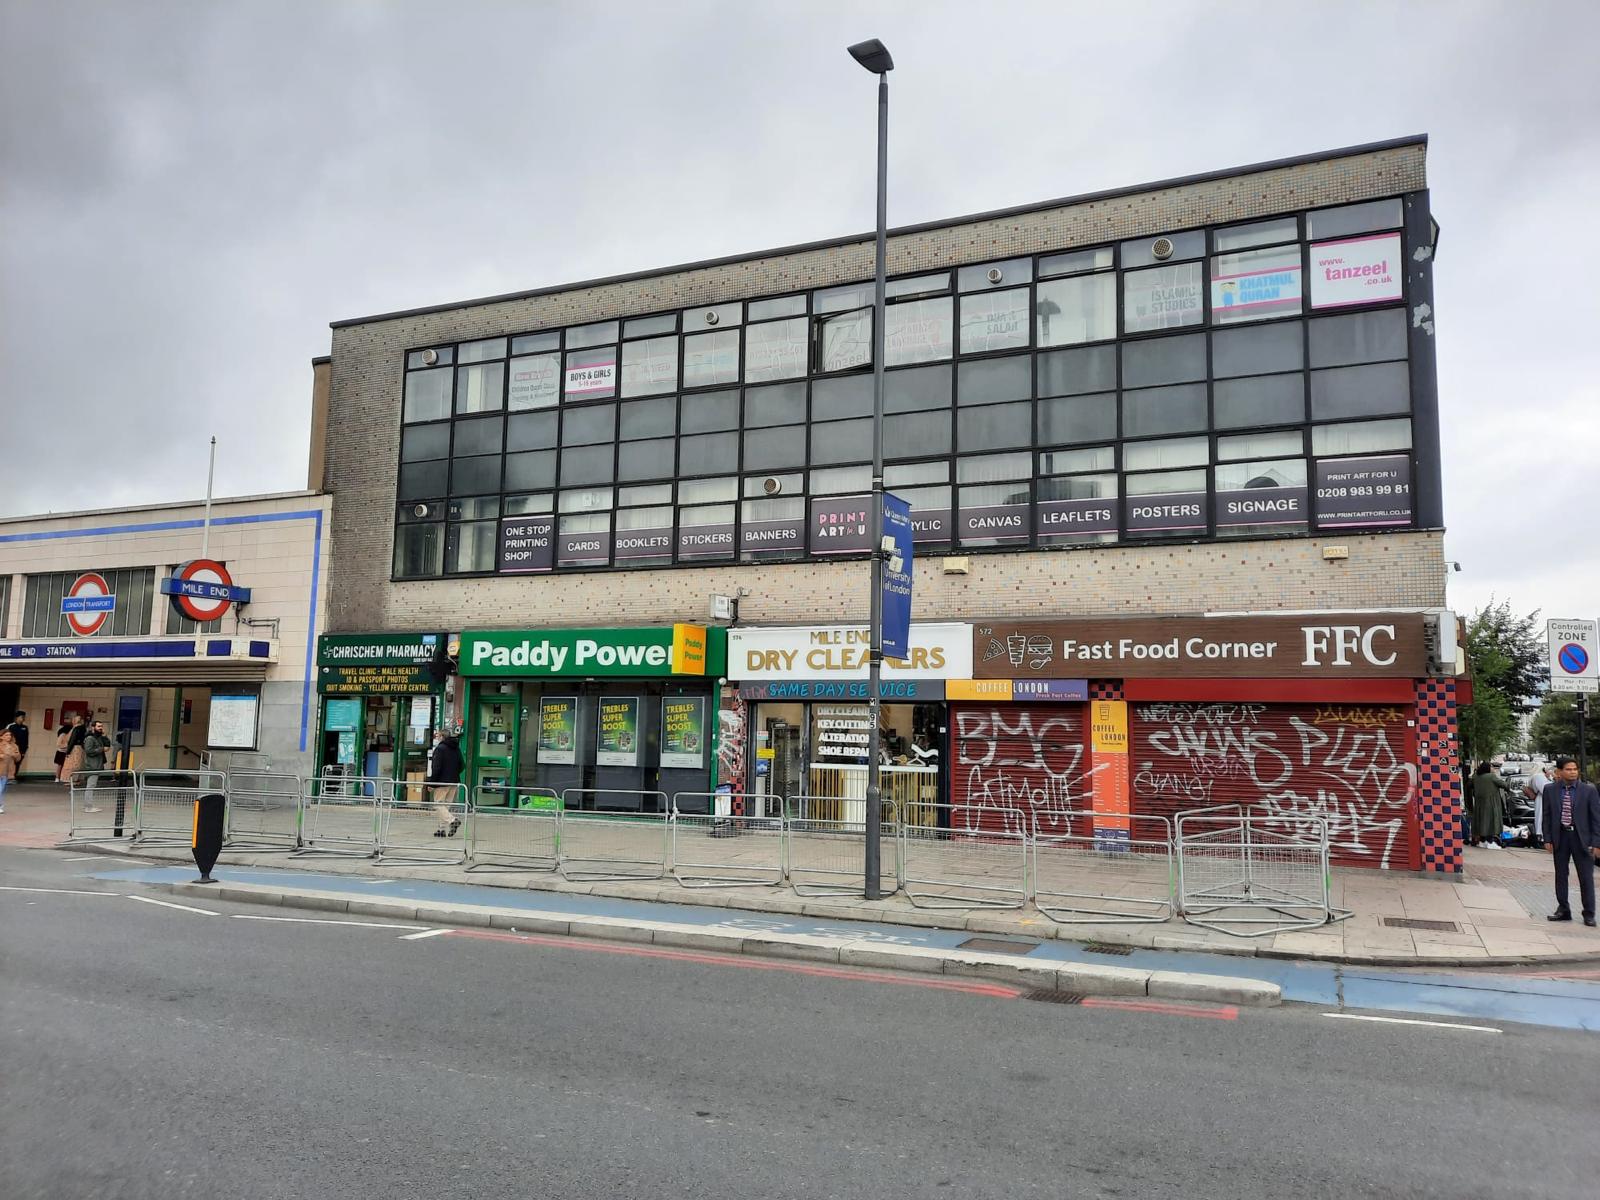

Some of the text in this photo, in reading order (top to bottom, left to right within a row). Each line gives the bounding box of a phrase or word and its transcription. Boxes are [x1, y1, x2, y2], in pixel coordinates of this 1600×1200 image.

[1318, 256, 1346, 267] www.
[1324, 260, 1388, 281] tanzeel
[1239, 271, 1296, 288] KHATMUL
[1363, 275, 1393, 286] .co.uk
[1151, 286, 1197, 302] ISLAMIC
[1239, 287, 1280, 304] QURAN
[1151, 297, 1197, 313] STUDIES
[570, 368, 612, 382] BOYS & GIRLS
[1327, 470, 1397, 481] PRINT ART FOR U
[1317, 483, 1409, 498] 0208 983 99 81
[1132, 504, 1200, 518] POSTERS
[1227, 498, 1298, 514] SIGNAGE
[818, 511, 866, 525] PRINT
[968, 515, 1022, 529] CANVAS
[1042, 509, 1111, 524] LEAFLETS
[505, 525, 551, 536] ONE STOP
[745, 529, 797, 541] BANNERS
[818, 526, 845, 537] ART
[858, 524, 866, 535] U
[505, 538, 548, 549] PRINTING
[616, 536, 669, 549] BOOKLETS
[681, 533, 733, 545] STICKERS
[567, 540, 601, 552] CARDS
[504, 551, 532, 561] SHOP!
[182, 583, 229, 597] MILE END
[889, 582, 911, 595] London
[1551, 622, 1593, 631] Controlled
[810, 630, 842, 645] MILE
[1558, 632, 1587, 641] ZONE
[1062, 637, 1278, 660] Fast Food Corner
[1300, 623, 1398, 666] FFC
[21, 647, 36, 656] END
[46, 646, 77, 656] STATION
[332, 644, 437, 659] CHRISCHEM PHARMACY
[472, 640, 568, 671] Paddy
[746, 649, 799, 672] DRY
[339, 667, 358, 675] TRAVEL
[359, 667, 377, 675] CLINIC
[382, 667, 397, 675] MALE
[398, 667, 419, 675] HEALTH
[359, 676, 386, 684] PASSPORT
[387, 675, 409, 684] PHOTOS
[339, 684, 363, 692] SMOKING
[369, 684, 390, 692] YELLOW
[390, 684, 407, 692] FEVER
[408, 684, 429, 692] CENTRE
[768, 682, 809, 698] SAME
[813, 682, 846, 698] DAY
[850, 682, 918, 698] SEVICE
[976, 682, 1050, 693] COFFEE LONDON
[543, 704, 567, 713] TREBLES
[602, 704, 629, 713] TREBLES
[666, 704, 694, 713] TREBLES
[543, 713, 561, 721] SUPER
[602, 713, 623, 722] SUPER
[666, 713, 688, 722] SUPER
[543, 721, 564, 730] BOOST
[602, 722, 626, 730] BOOST
[666, 722, 692, 731] BOOST
[817, 719, 869, 730] KEY CUTTIN
[1093, 724, 1115, 733] COFFEE
[1101, 733, 1126, 741] LONDON
[818, 745, 870, 757] SHOE REPAI
